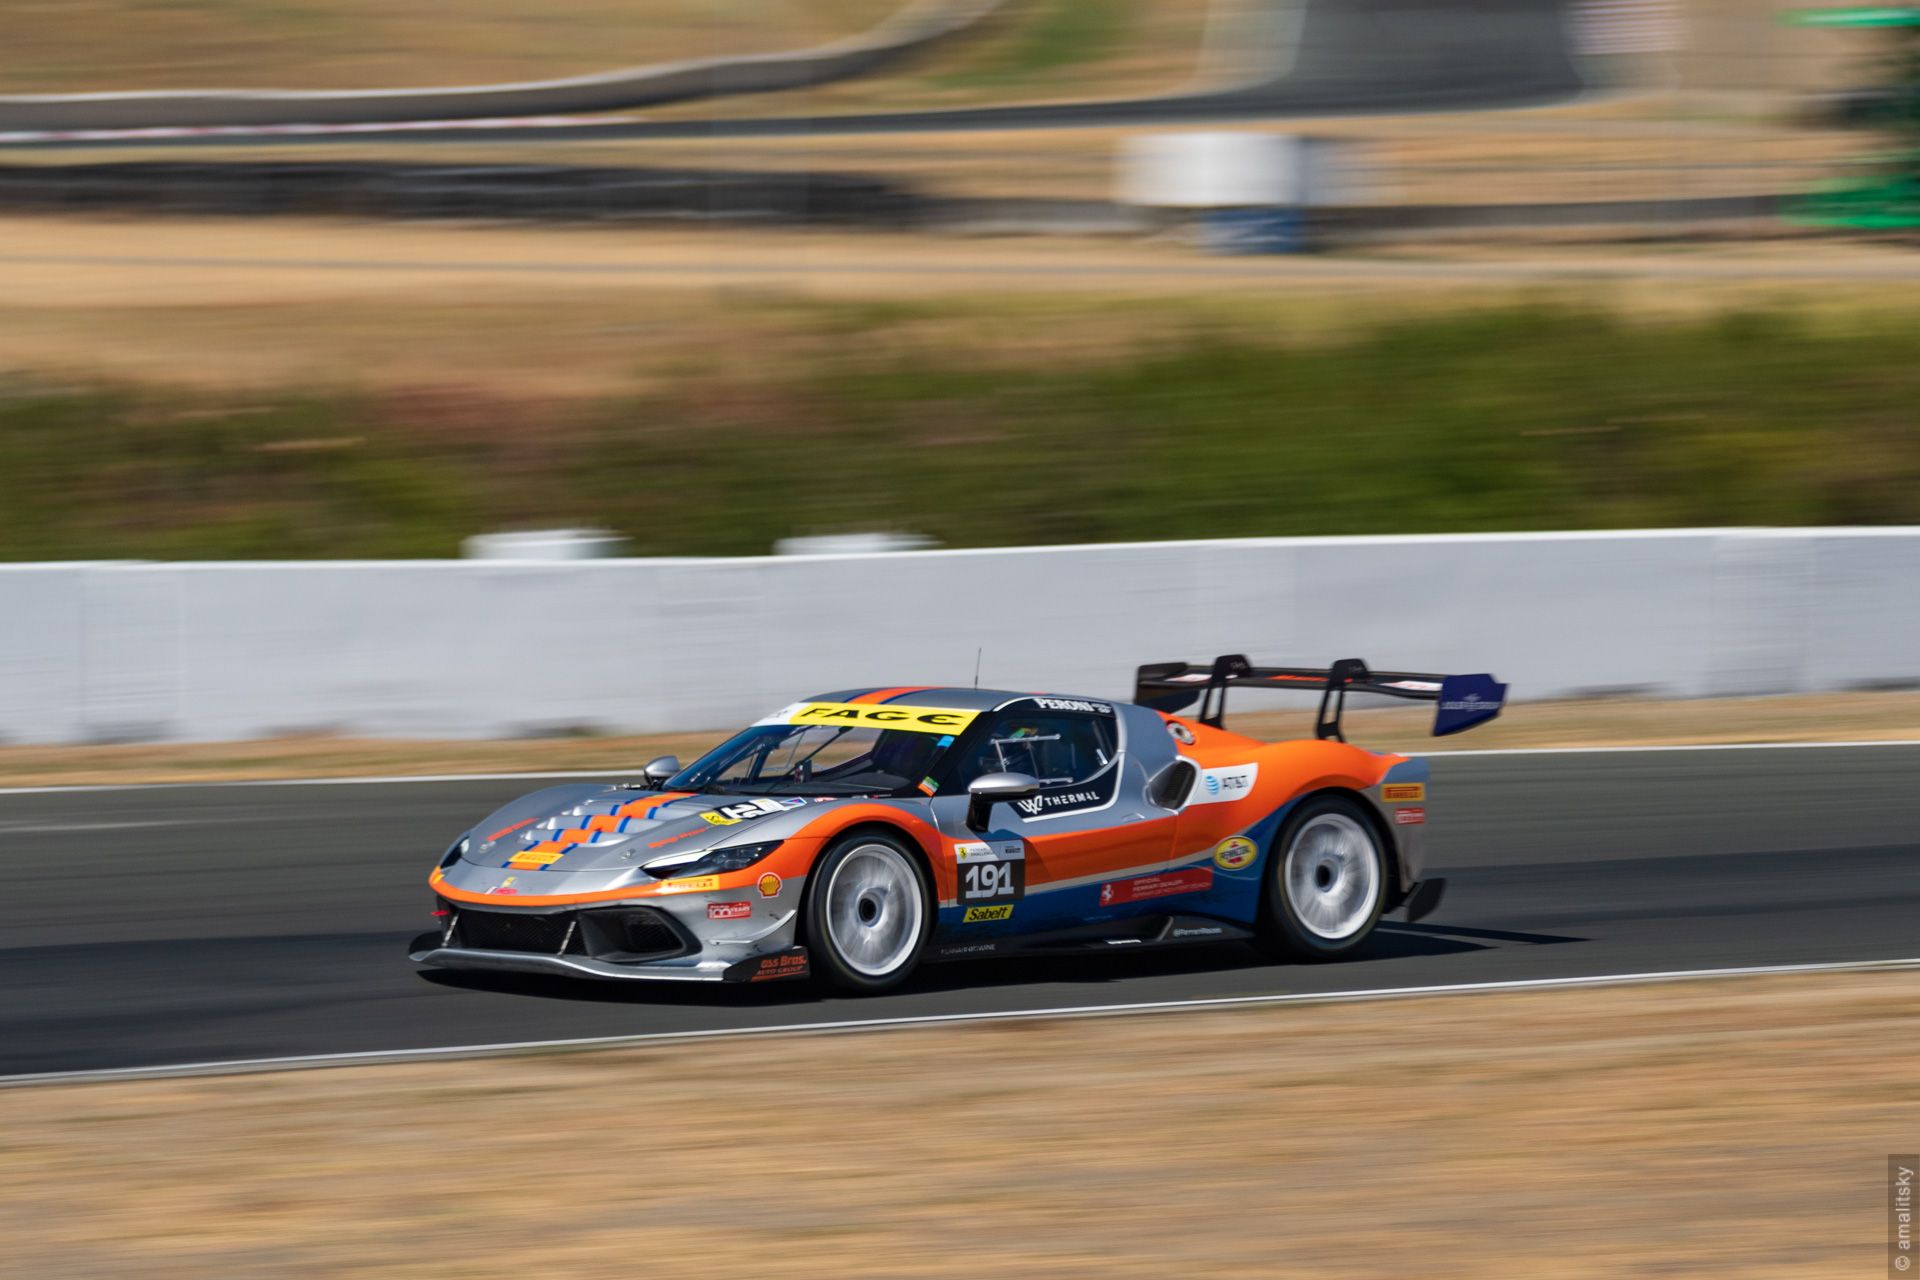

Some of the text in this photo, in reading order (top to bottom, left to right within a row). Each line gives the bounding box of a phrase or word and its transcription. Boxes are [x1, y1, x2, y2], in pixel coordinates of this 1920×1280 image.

[1034, 698, 1095, 712] PERONI
[800, 708, 966, 725] FAGE
[1044, 791, 1100, 806] THERMAL
[965, 862, 1015, 899] 191
[969, 907, 1009, 921] Sabelt
